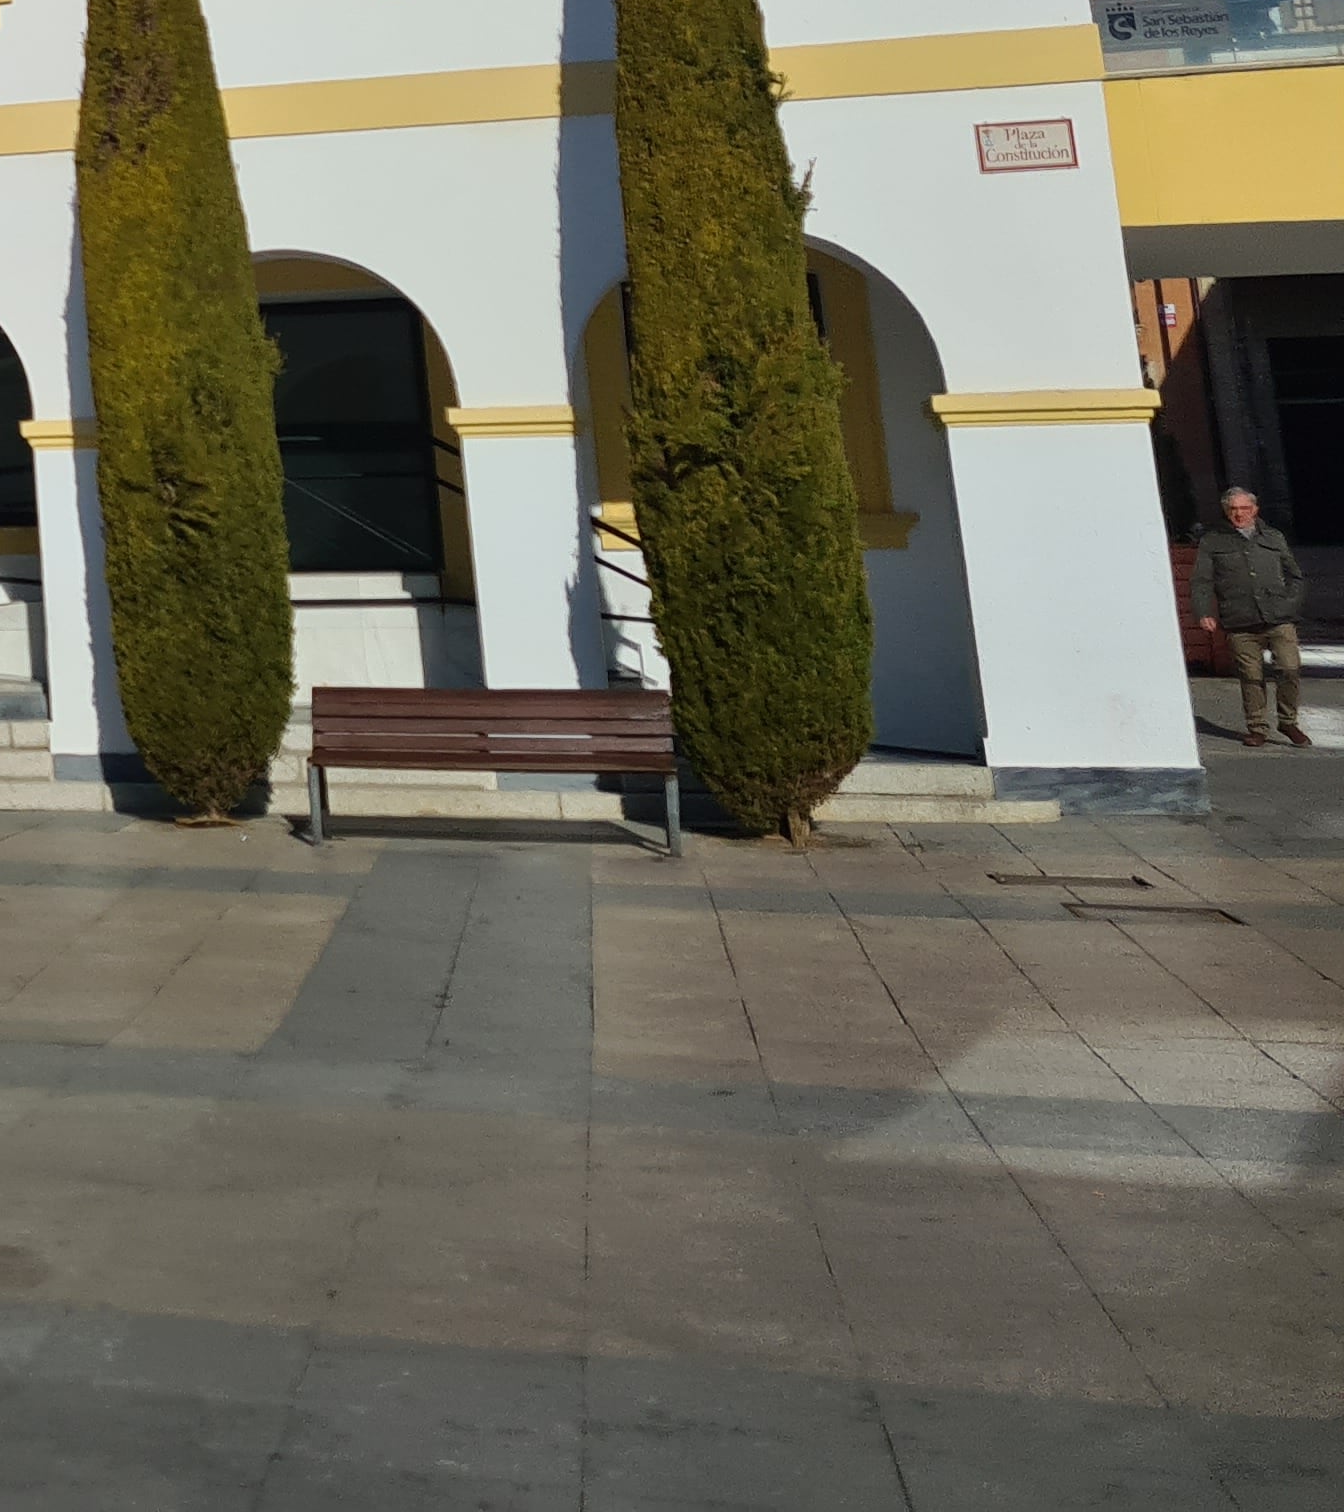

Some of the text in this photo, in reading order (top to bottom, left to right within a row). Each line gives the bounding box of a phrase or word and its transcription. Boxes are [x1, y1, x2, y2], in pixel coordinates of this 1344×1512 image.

[1142, 16, 1165, 28] San
[1004, 127, 1046, 143] Plaza
[985, 144, 1070, 163] Constitución
